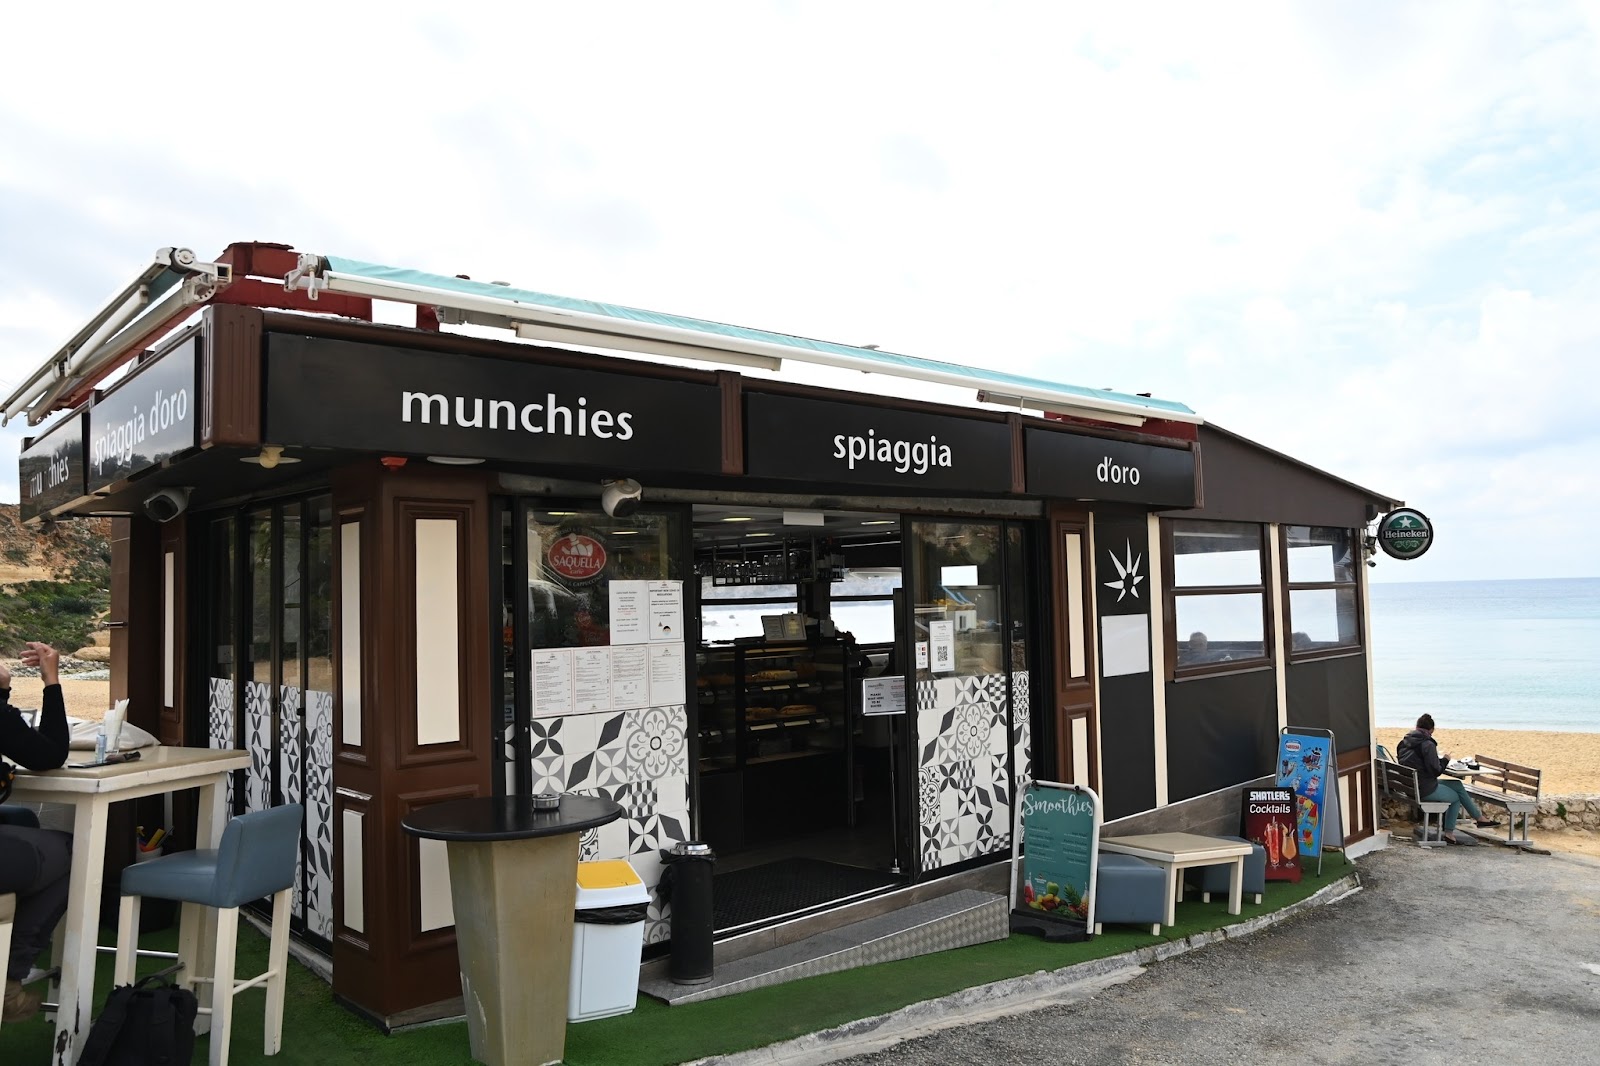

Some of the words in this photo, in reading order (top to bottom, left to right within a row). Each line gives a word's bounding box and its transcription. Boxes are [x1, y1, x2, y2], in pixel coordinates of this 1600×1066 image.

[402, 391, 634, 441] munchies
[94, 405, 145, 476] spiaggia
[149, 388, 188, 436] d'oro
[833, 428, 952, 475] spiaggia
[1096, 456, 1140, 485] d'oro
[1384, 529, 1427, 539] Heineken
[553, 555, 601, 570] SAQUELLA
[1024, 793, 1094, 817] Smoothies
[1249, 803, 1291, 814] Cocktails
